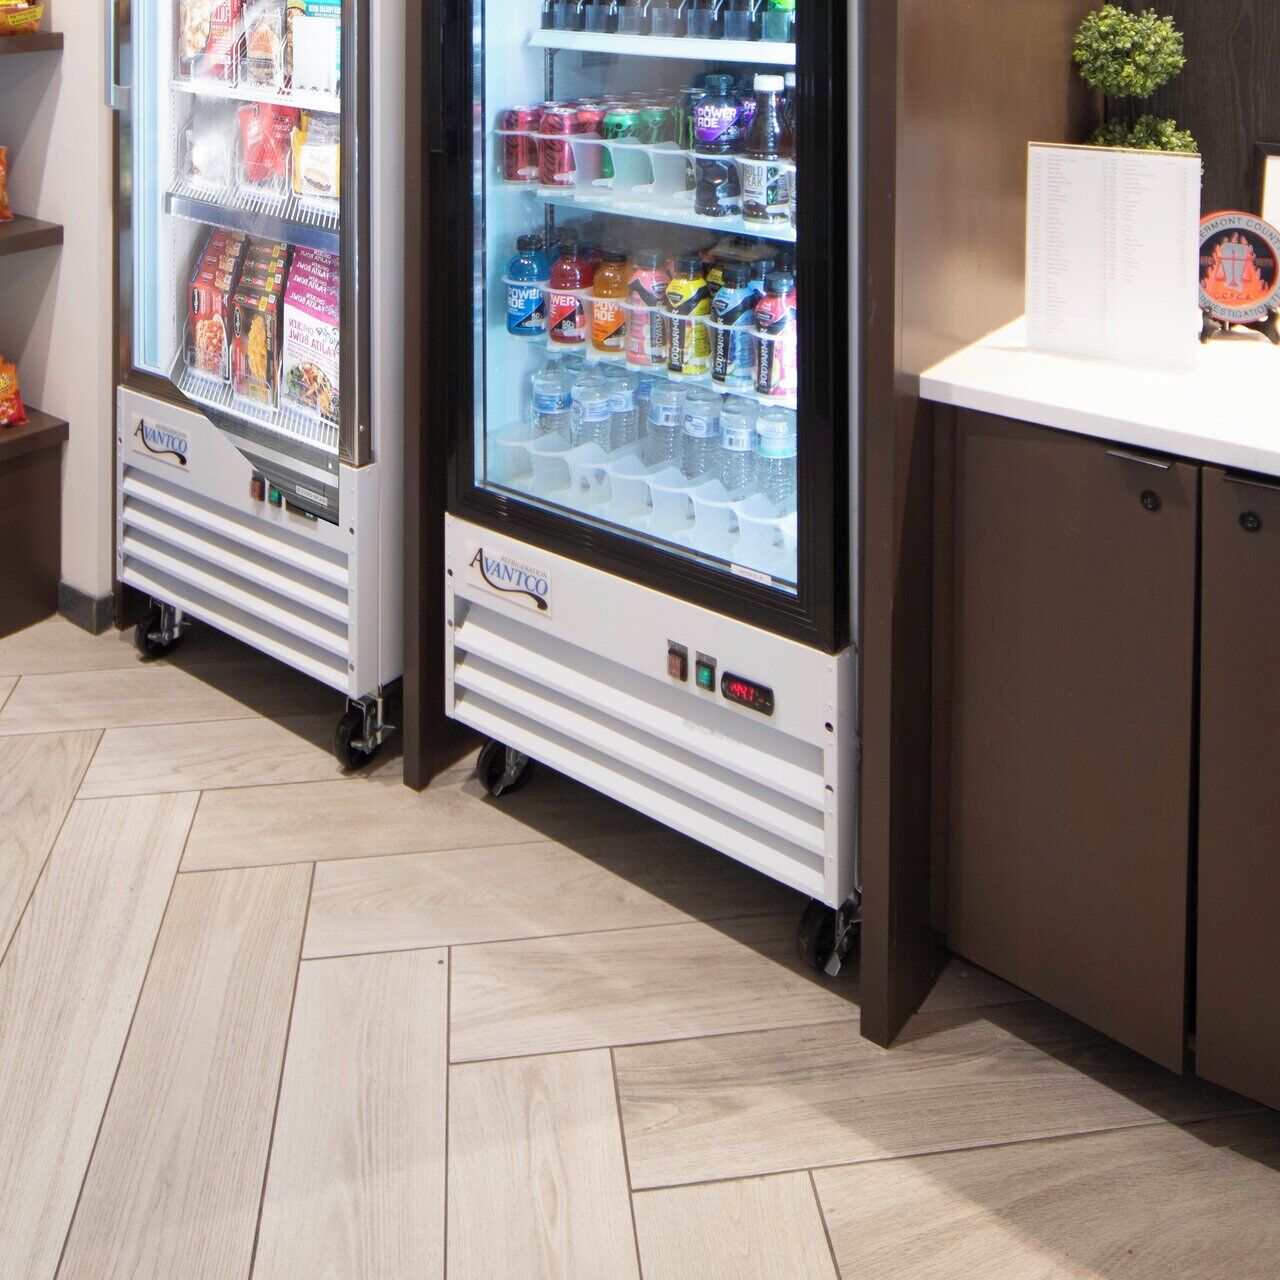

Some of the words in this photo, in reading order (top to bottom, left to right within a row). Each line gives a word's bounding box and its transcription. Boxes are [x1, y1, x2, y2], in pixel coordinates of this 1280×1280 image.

[697, 107, 737, 119] POWER
[1200, 217, 1241, 238] ERMONT
[134, 418, 188, 454] AVANTCO
[468, 547, 549, 597] AVANTCO
